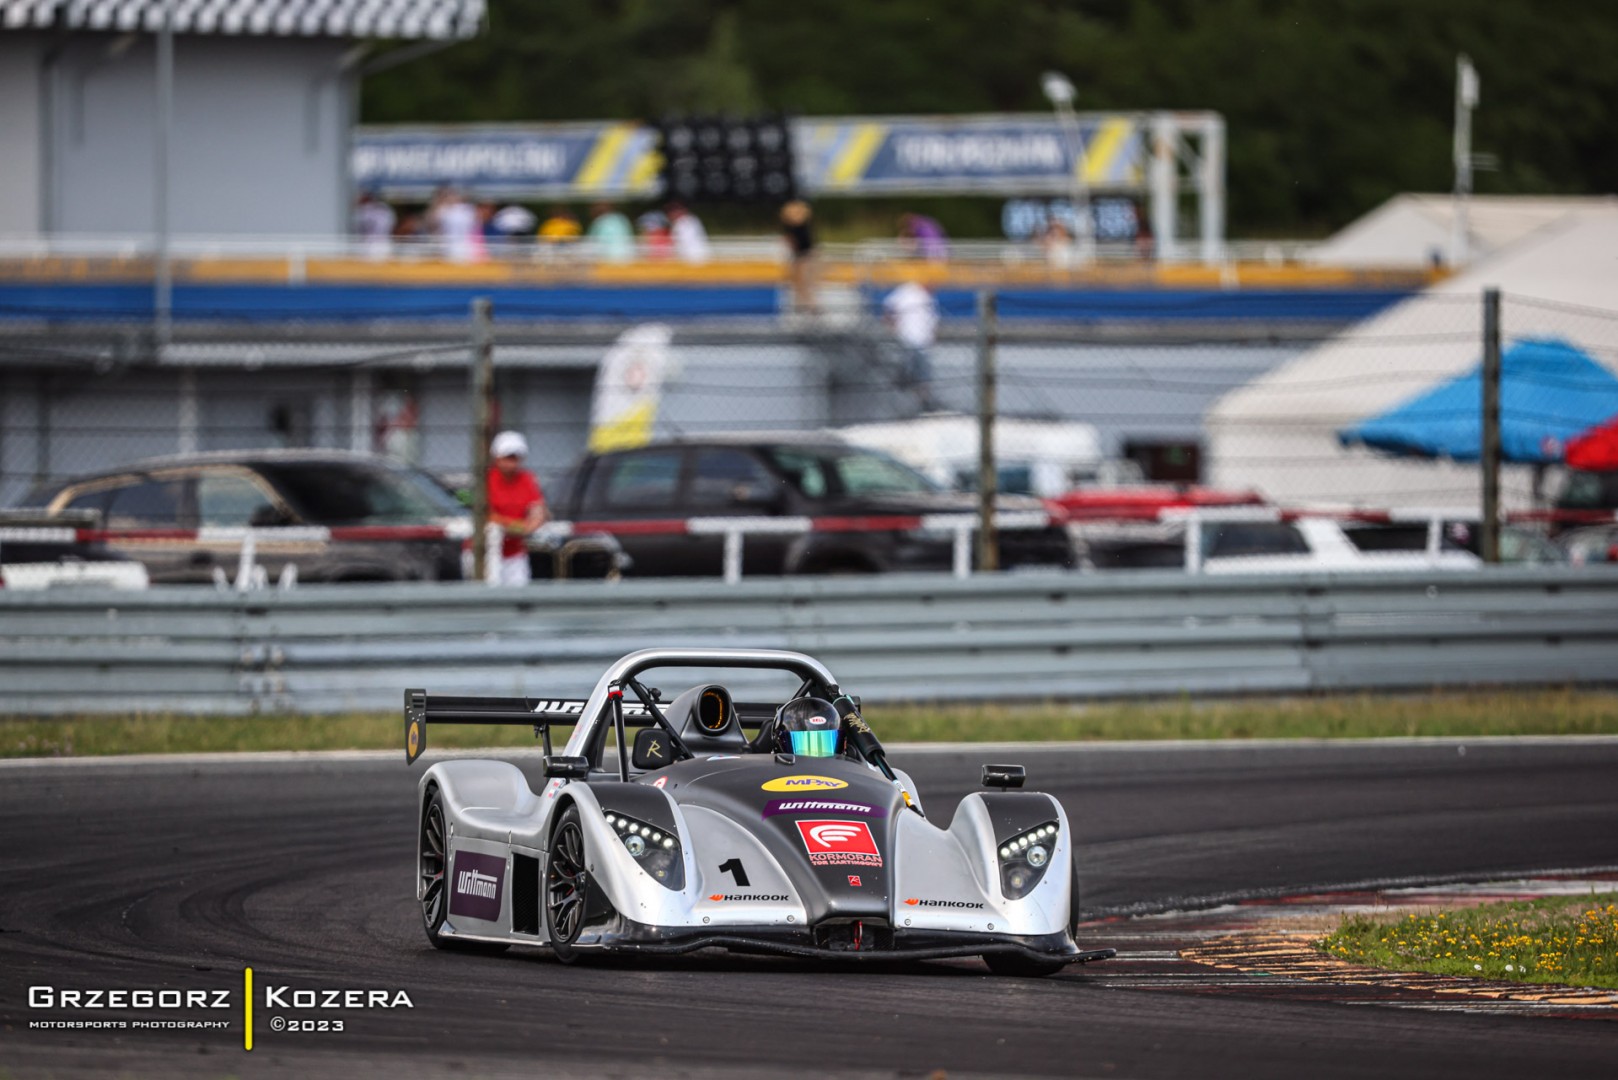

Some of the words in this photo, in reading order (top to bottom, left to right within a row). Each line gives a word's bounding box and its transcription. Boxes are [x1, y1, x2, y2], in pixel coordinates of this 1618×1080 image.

[646, 740, 663, 758] R
[779, 801, 871, 812] wittmann
[809, 853, 882, 862] KORMORAN
[718, 858, 750, 886] 1
[457, 869, 497, 899] wittmann
